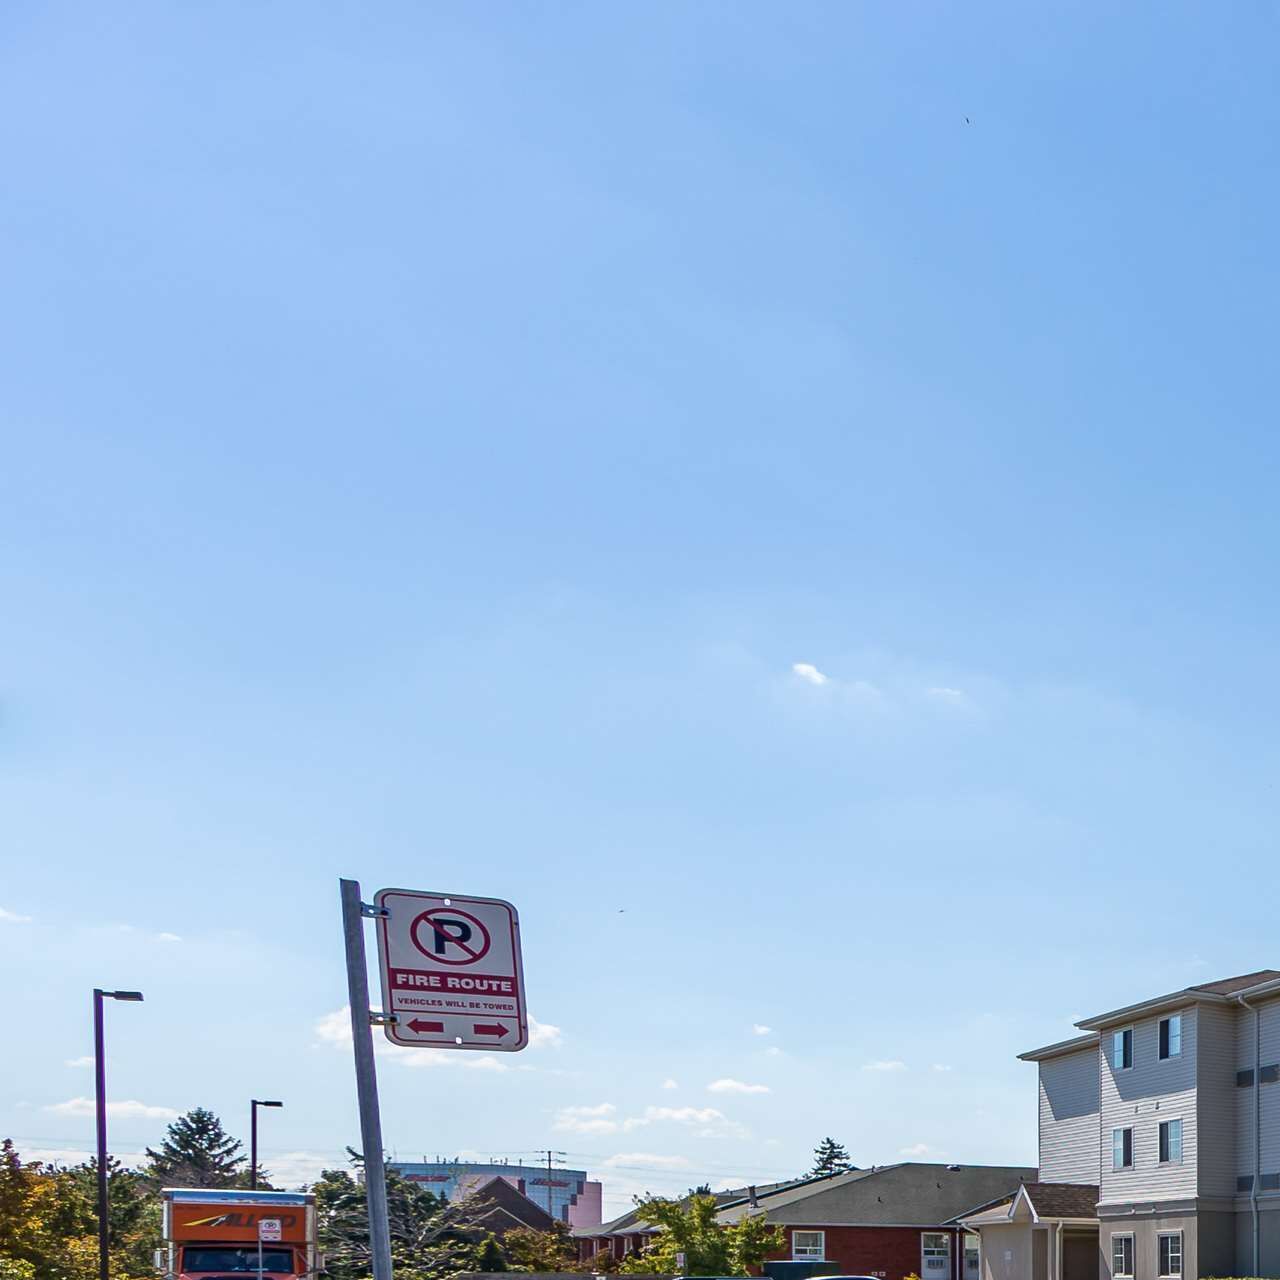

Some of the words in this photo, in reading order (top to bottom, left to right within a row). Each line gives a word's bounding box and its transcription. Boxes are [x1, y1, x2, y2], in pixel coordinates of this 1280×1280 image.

[396, 973, 442, 988] FIRE
[447, 977, 513, 993] ROUTE
[397, 997, 443, 1007] VEHICLES
[445, 1000, 467, 1009] WILL
[469, 1001, 481, 1010] BE
[483, 1002, 514, 1011] TOWED
